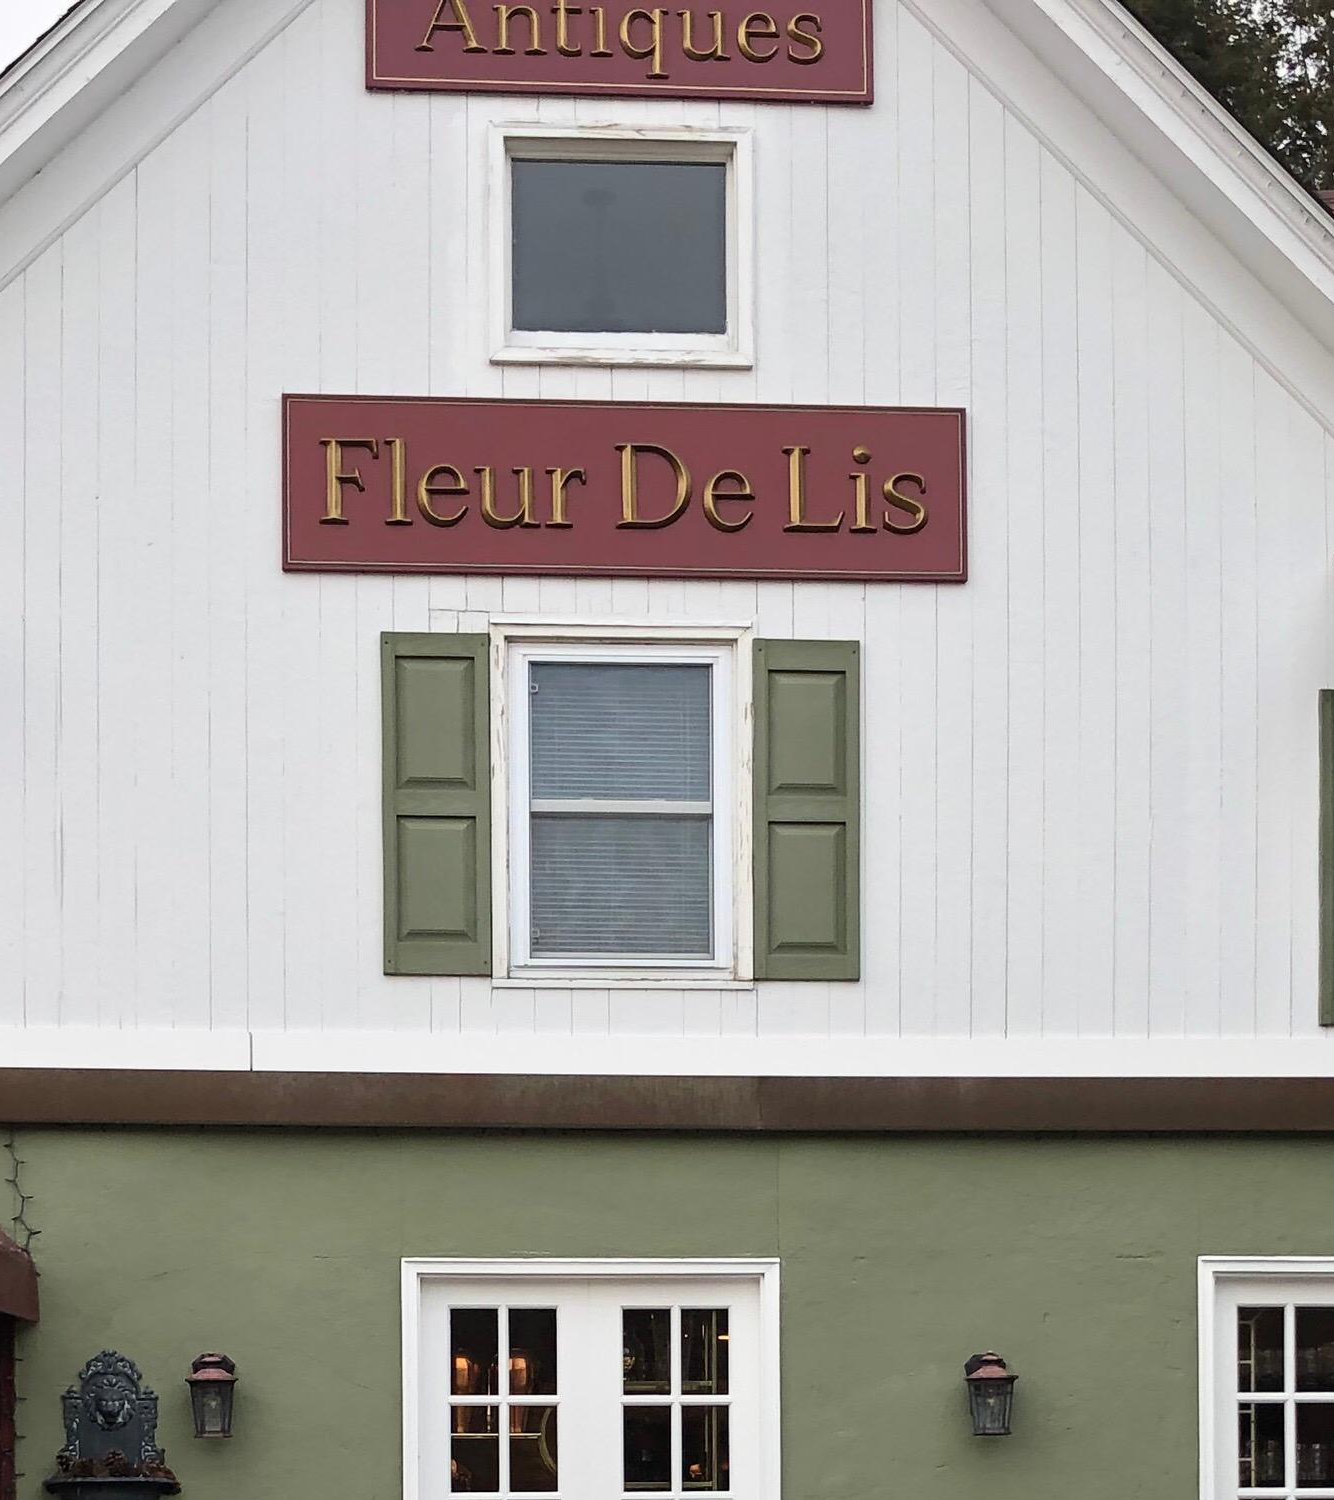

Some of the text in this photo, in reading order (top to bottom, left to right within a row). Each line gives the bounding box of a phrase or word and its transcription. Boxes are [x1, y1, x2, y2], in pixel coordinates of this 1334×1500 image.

[414, 0, 825, 79] Antiques
[318, 437, 929, 535] Fleur De Lis
